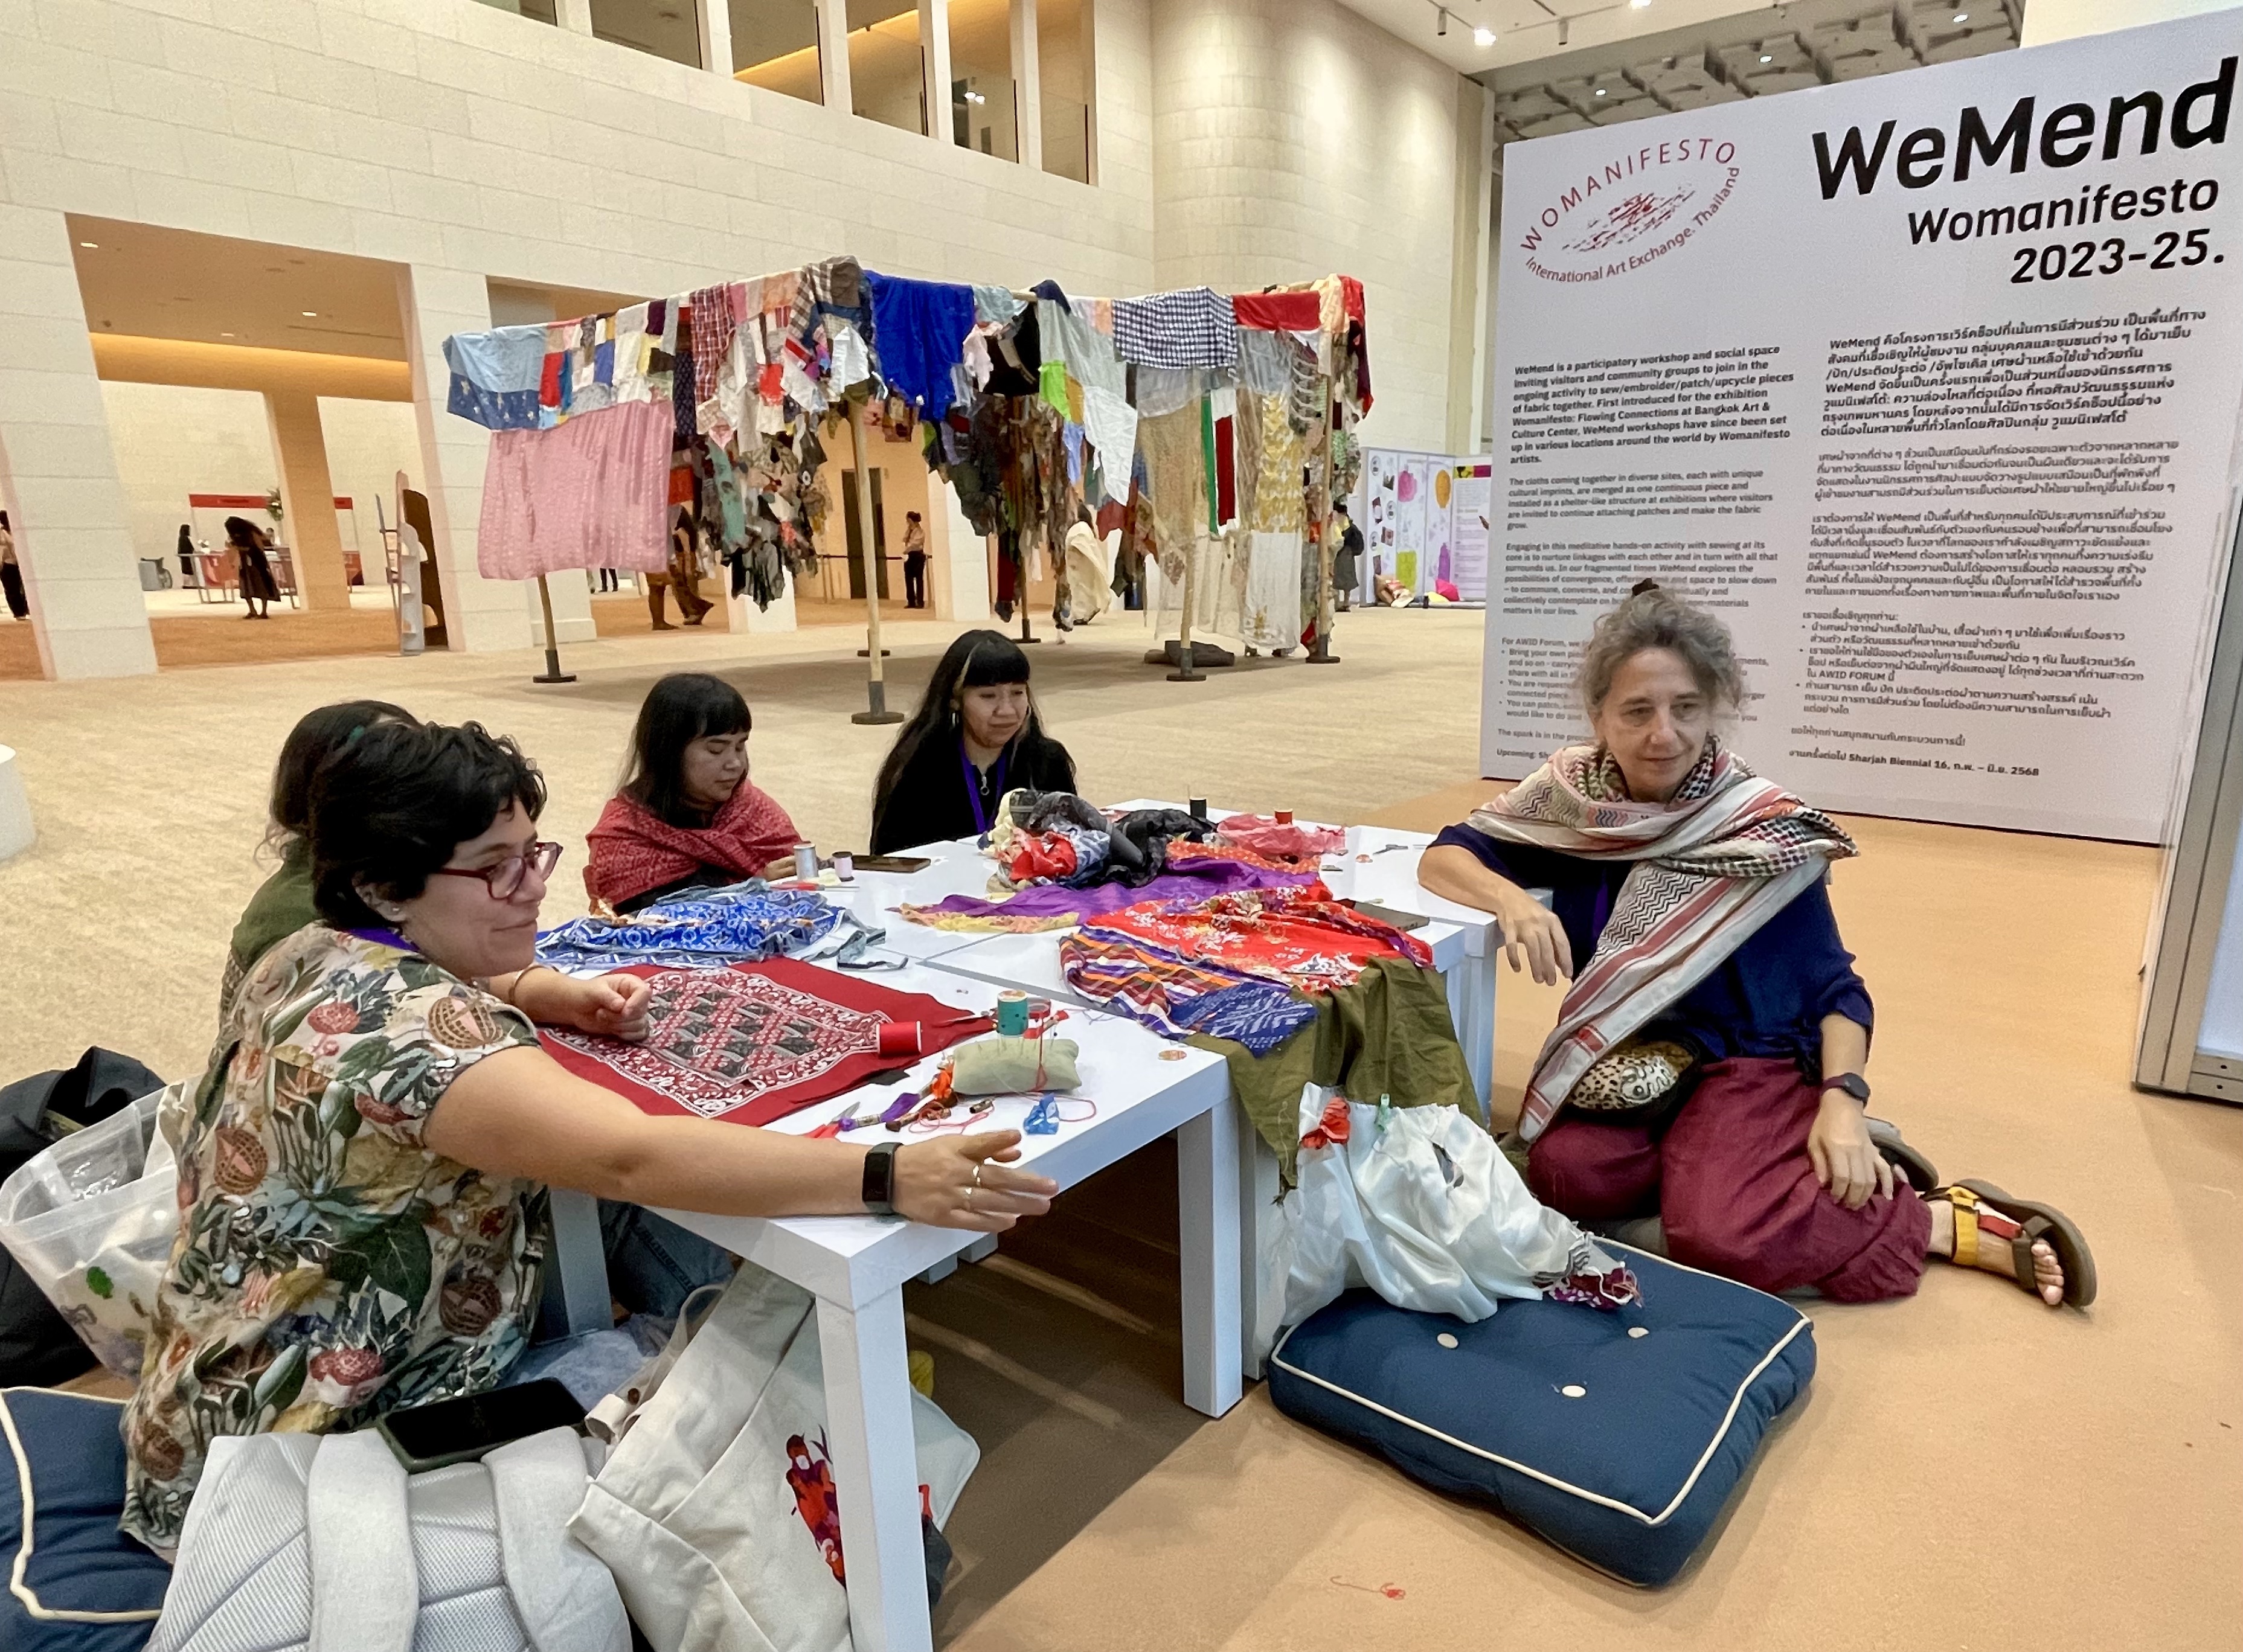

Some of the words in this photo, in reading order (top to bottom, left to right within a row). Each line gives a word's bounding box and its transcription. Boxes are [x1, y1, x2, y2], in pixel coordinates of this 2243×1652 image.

[1812, 56, 2239, 200] WeMend
[1520, 138, 1736, 251] WOMANIFESTO
[1525, 255, 1603, 283] International
[1605, 261, 1626, 278] Art
[1692, 167, 1740, 226] Thailand
[1908, 179, 2219, 245] Womanifesto
[2010, 228, 2225, 284] 2023-25.
[1830, 337, 1881, 348] WeMend
[1513, 377, 1548, 388] inviting
[1550, 375, 1585, 385] visitors
[1586, 372, 1605, 383] and
[1606, 368, 1663, 381] community
[1664, 366, 1701, 379] groups
[1702, 365, 1714, 374] to
[1715, 362, 1736, 375] join
[1737, 361, 1748, 371] in
[1750, 360, 1769, 370] the
[1515, 363, 1555, 375] WeMend
[1556, 363, 1565, 372] is
[1574, 358, 1638, 371] participatory
[1640, 353, 1690, 365] workshop
[1692, 350, 1713, 360] and
[1714, 347, 1746, 359] social
[1748, 347, 1780, 357] space
[1513, 391, 1550, 403] ongoing
[1551, 387, 1587, 399] activity
[1588, 387, 1598, 395] to
[1600, 374, 1756, 395] sew/embroider/patch/upcycle
[1758, 373, 1794, 385] pieces
[1825, 381, 1876, 392] WeMend
[1512, 404, 1522, 414] of
[1523, 403, 1551, 413] fabric
[1596, 398, 1619, 408] First
[1621, 393, 1675, 406] introduced
[1677, 392, 1693, 402] for
[1695, 392, 1712, 402] the
[1713, 388, 1768, 400] exhibition
[1577, 412, 1616, 422] Flowing
[1617, 408, 1679, 420] Connections
[1681, 407, 1692, 416] at
[1694, 403, 1740, 417] Bangkok
[1742, 403, 1760, 412] Art
[1762, 402, 1771, 412] &
[1510, 444, 1523, 453] up
[1524, 442, 1534, 450] in
[1535, 440, 1569, 450] various
[1571, 438, 1614, 448] locations
[1616, 435, 1651, 446] around
[1653, 435, 1670, 444] the
[1672, 432, 1702, 443] world
[1703, 432, 1717, 444] by
[1719, 429, 1791, 441] Womanifesto
[1511, 430, 1545, 439] Culture
[1582, 423, 1625, 435] WeMend
[1626, 421, 1681, 432] workshops
[1683, 419, 1708, 429] have
[1710, 418, 1738, 428] since
[1740, 417, 1767, 426] been
[1770, 415, 1788, 425] set
[1848, 754, 1887, 764] Sharjah
[1889, 757, 1932, 767] Biennial
[2010, 766, 2039, 776] 2568
